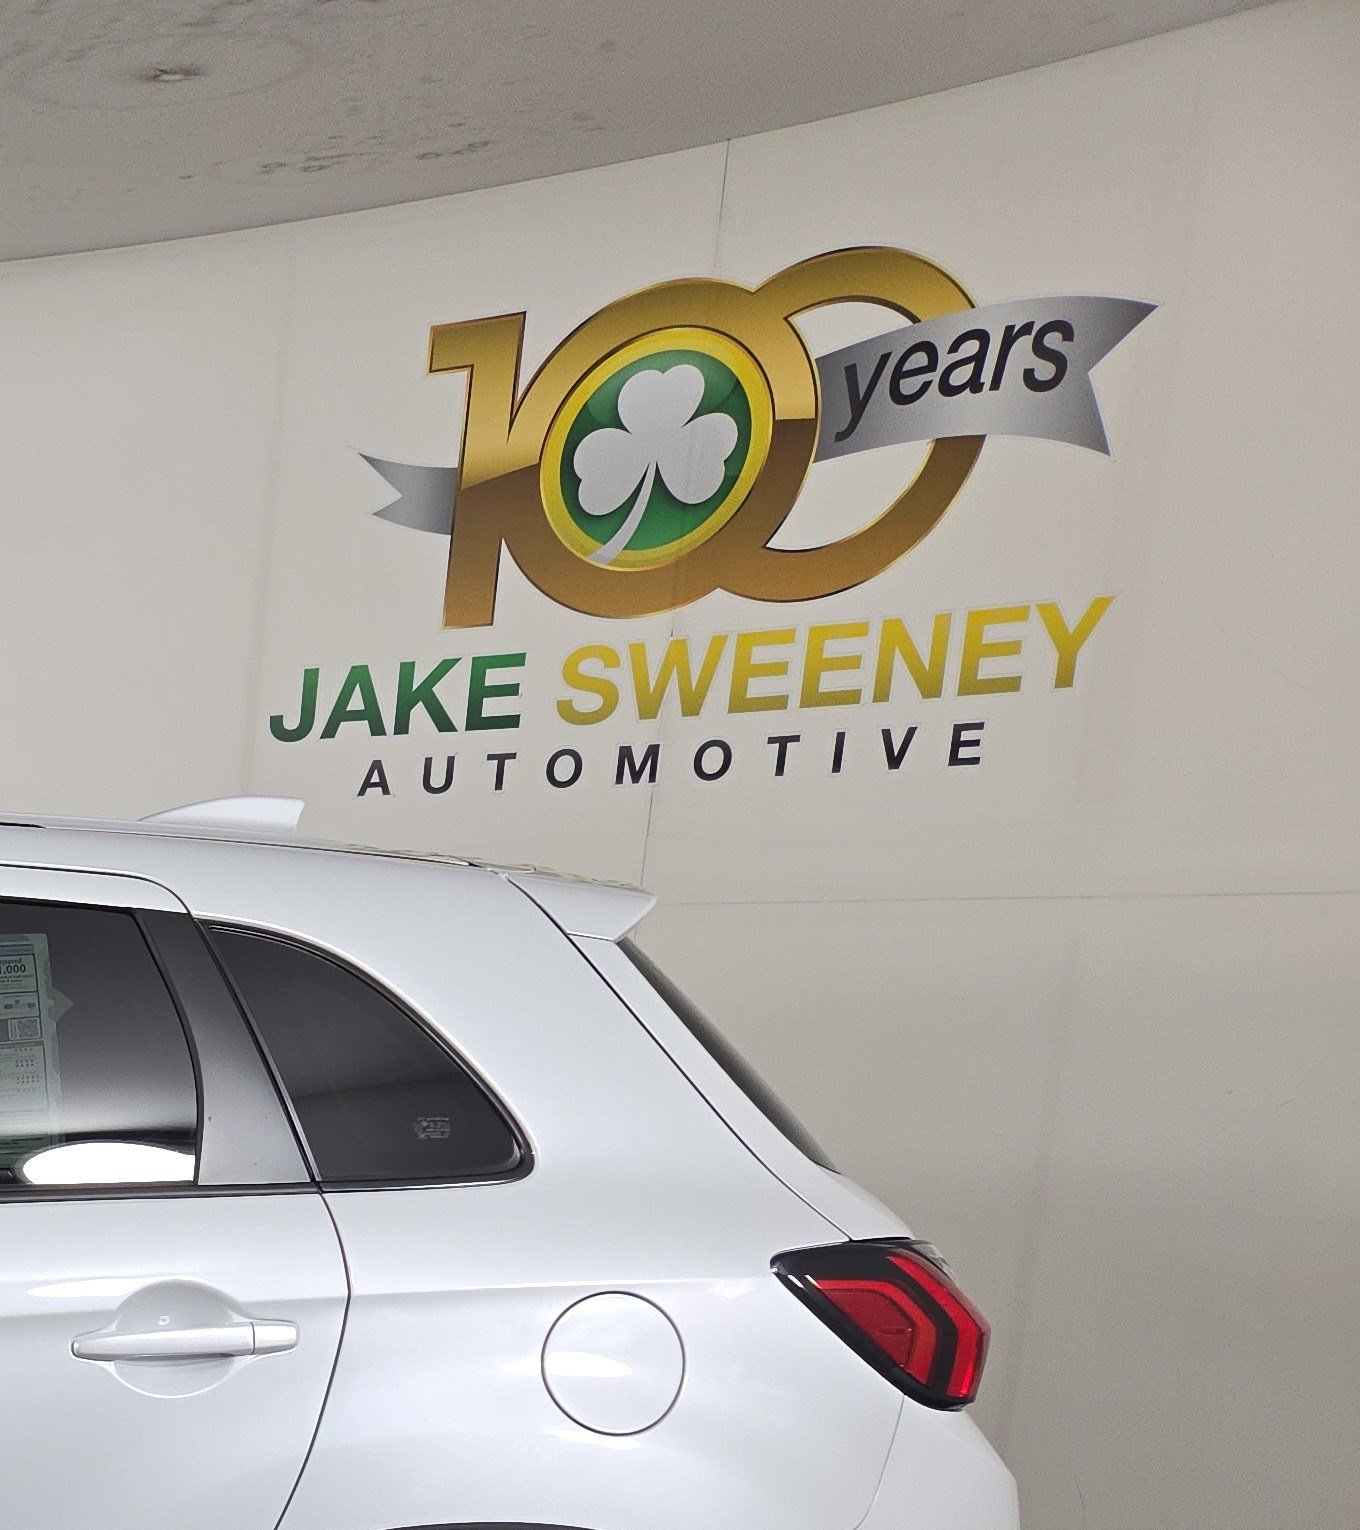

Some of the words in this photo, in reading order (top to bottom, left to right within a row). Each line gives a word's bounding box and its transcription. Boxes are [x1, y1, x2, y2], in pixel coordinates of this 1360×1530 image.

[834, 319, 1075, 443] years
[268, 652, 528, 745] JAKE
[556, 595, 1116, 726] SWEENEY
[357, 721, 987, 799] AUTOMOTIVE
